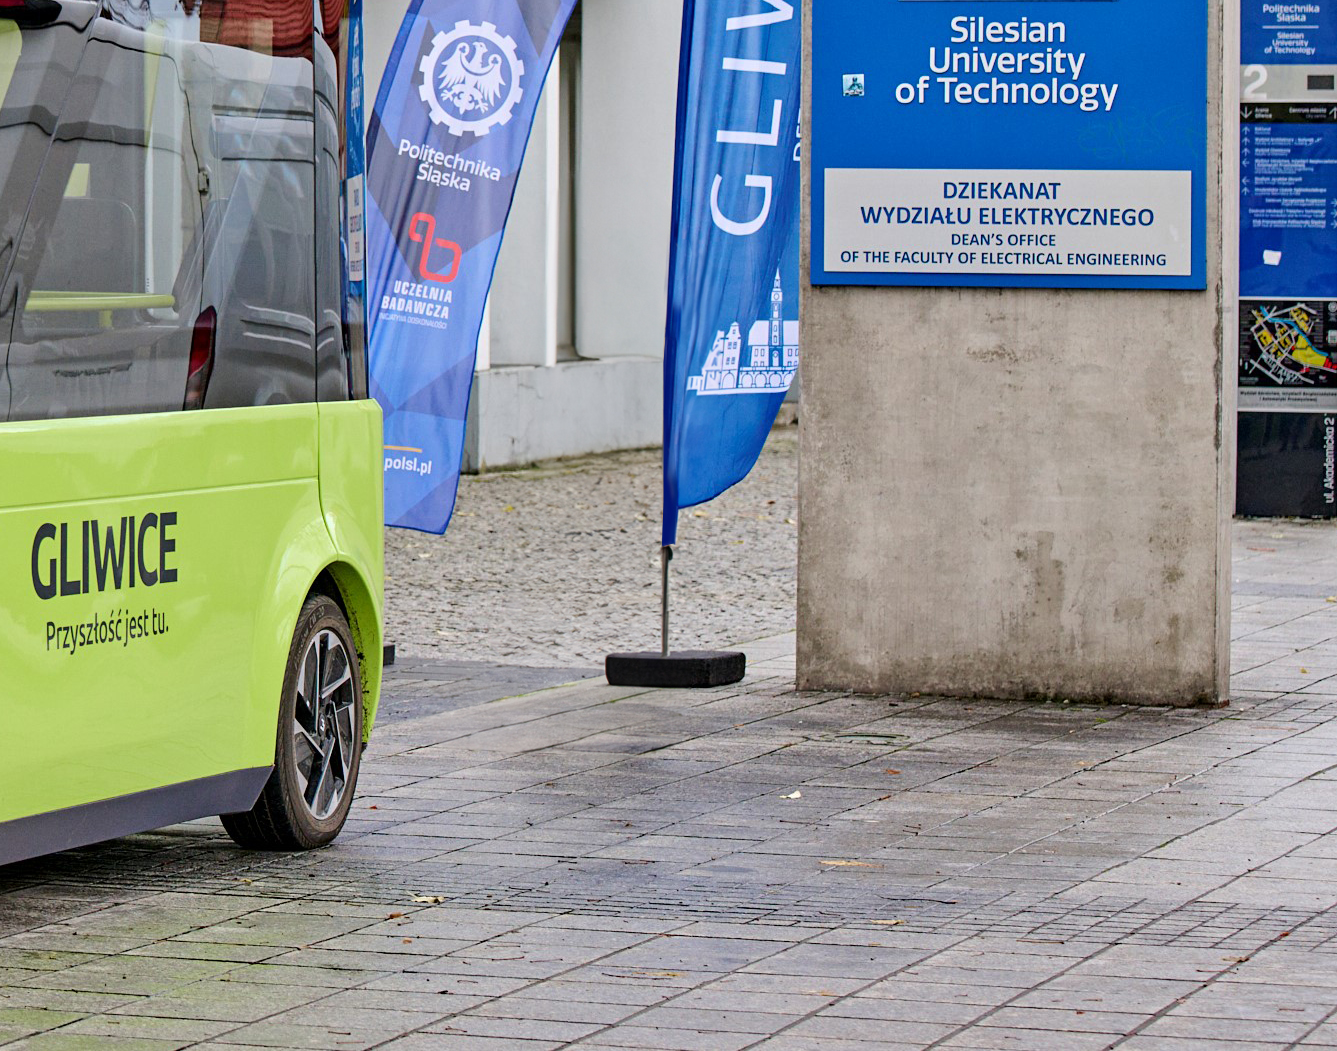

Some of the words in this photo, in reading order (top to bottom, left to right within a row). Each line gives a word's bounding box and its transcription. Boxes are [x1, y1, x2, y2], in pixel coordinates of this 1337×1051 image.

[1263, 4, 1320, 13] Politechnika
[950, 15, 1066, 43] Silesian
[929, 46, 1086, 80] University
[895, 75, 930, 104] of
[937, 77, 1119, 111] Technology
[1244, 64, 1268, 100] 2
[398, 138, 501, 181] Politechnika
[417, 161, 471, 192] Śląska
[943, 181, 1061, 200] DZIEKANAT
[861, 206, 971, 225] WYDZIAŁU
[979, 207, 1154, 227] ELEKTRYCZNEGO
[1008, 233, 1056, 247] OFFICE
[840, 251, 859, 264] OF
[863, 251, 890, 264] THE
[894, 251, 953, 265] FACULTY
[958, 252, 977, 265] OF
[981, 252, 1063, 266] ELECTRICAL
[1067, 253, 1167, 267] ENGINEERING
[394, 280, 453, 304] UCZELNIA
[381, 295, 450, 320] BADAWCZA
[384, 456, 432, 476] polsl.pl
[1323, 427, 1335, 489] Akademicka
[31, 511, 178, 600] GLIWICE
[46, 608, 122, 655] Przyszłość
[123, 609, 149, 647] jest
[152, 608, 169, 635] tu.
